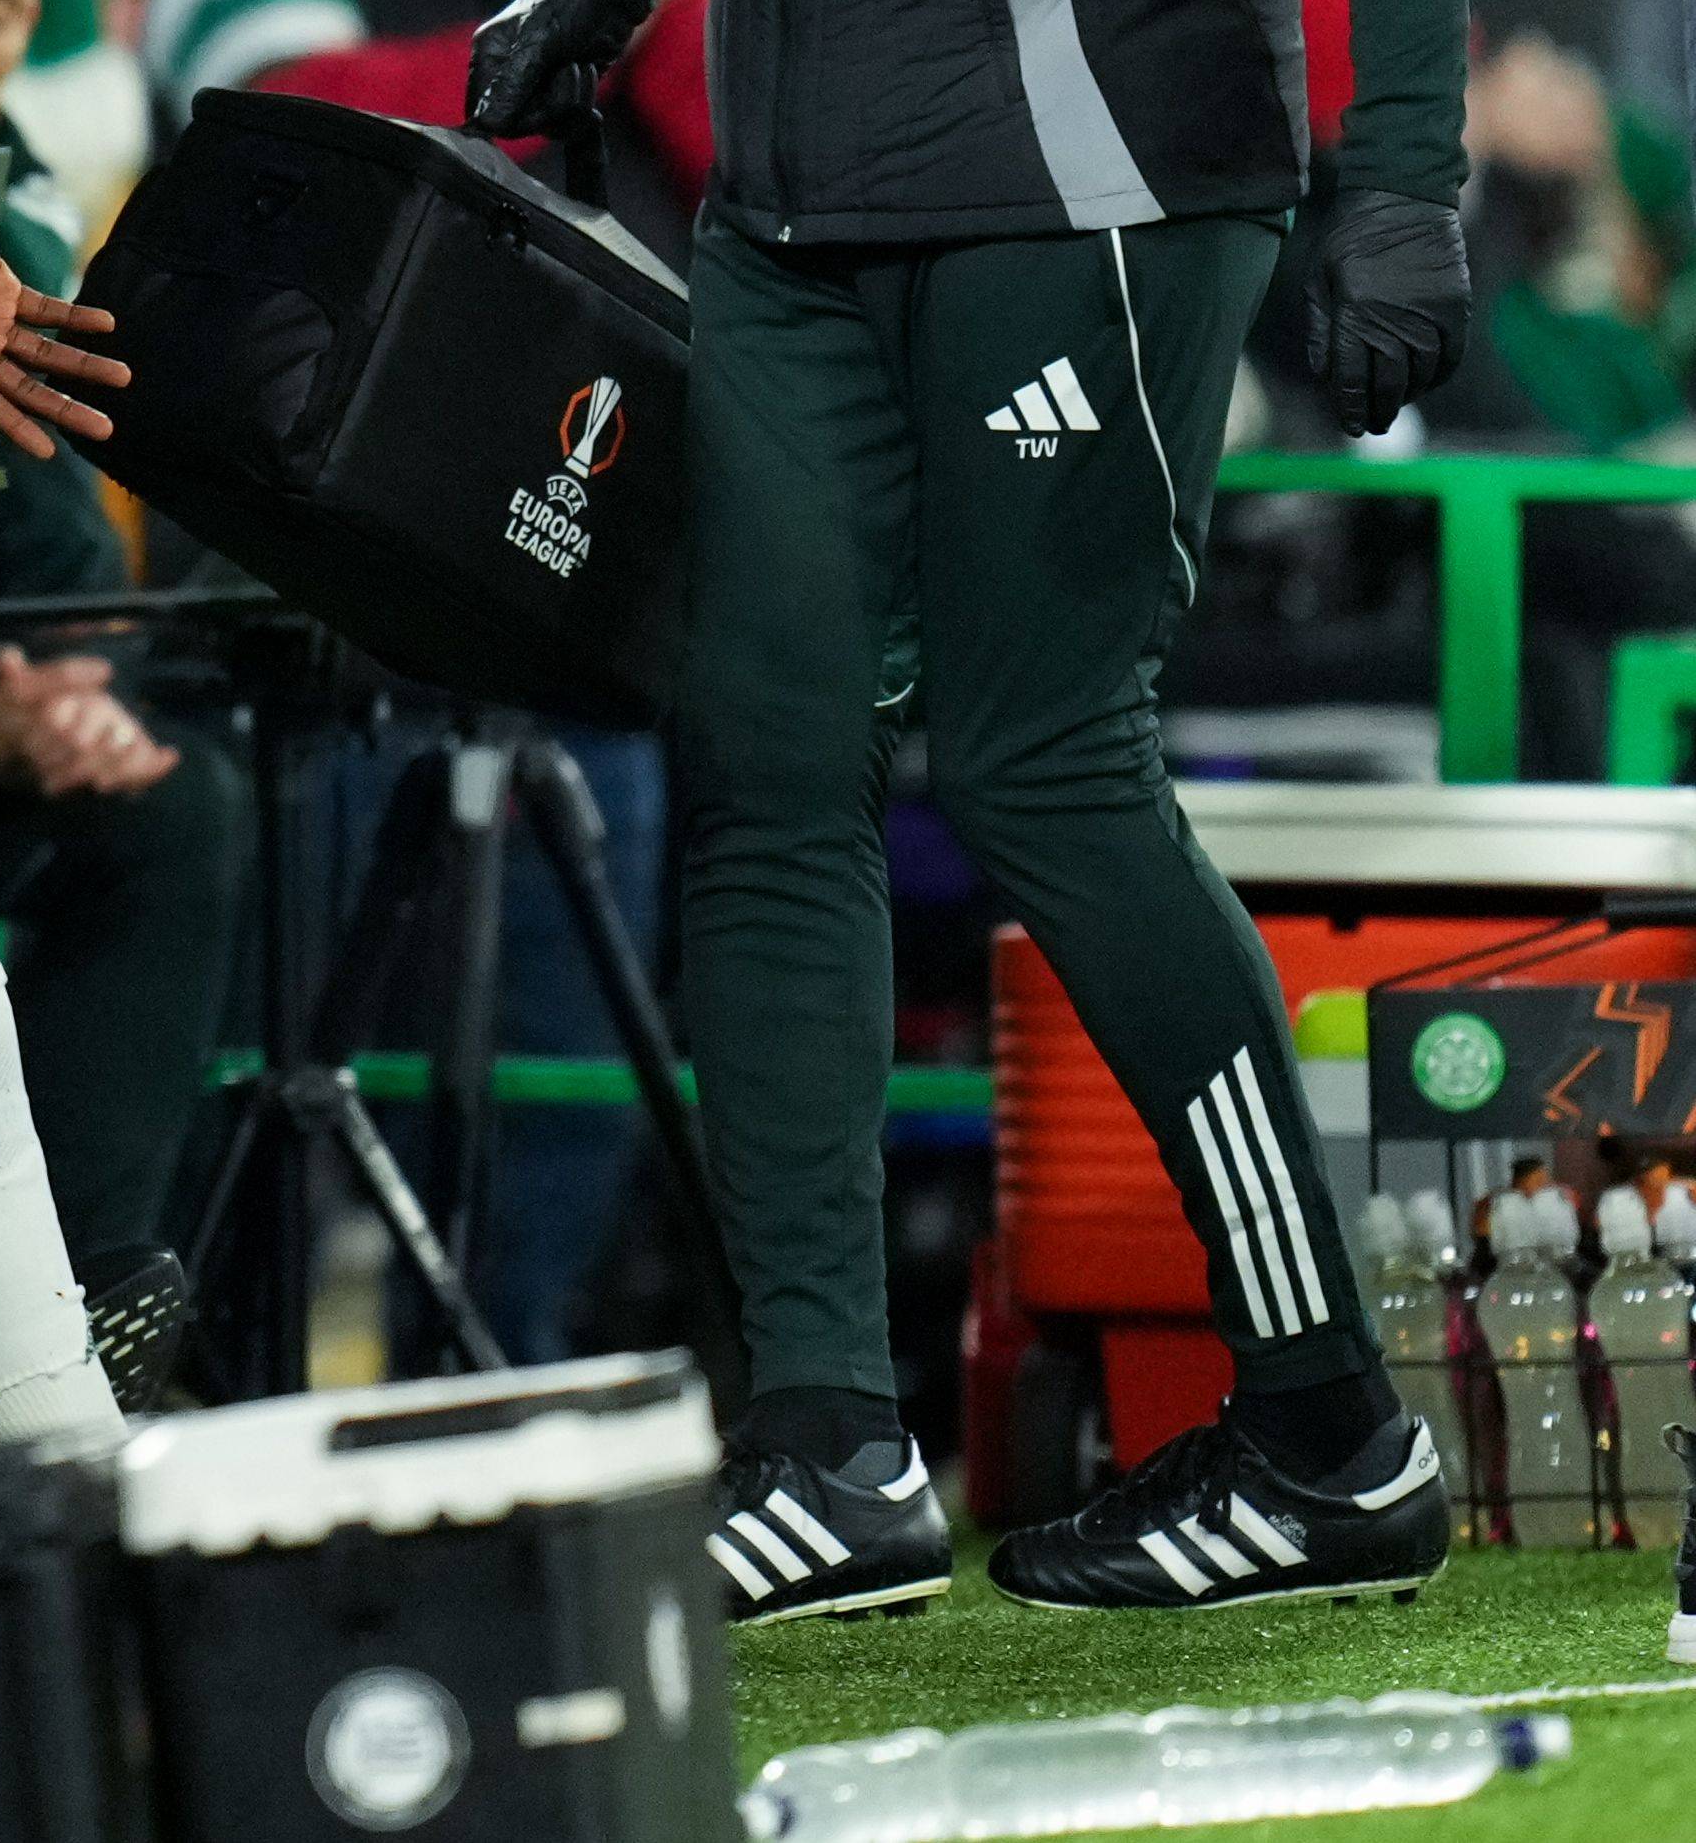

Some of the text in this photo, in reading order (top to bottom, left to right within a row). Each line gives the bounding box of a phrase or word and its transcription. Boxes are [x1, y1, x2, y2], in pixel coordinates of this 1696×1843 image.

[1014, 436, 1059, 459] TW
[546, 480, 583, 514] UEFA
[508, 486, 592, 560] EUROPA
[504, 517, 579, 579] LEAGUE
